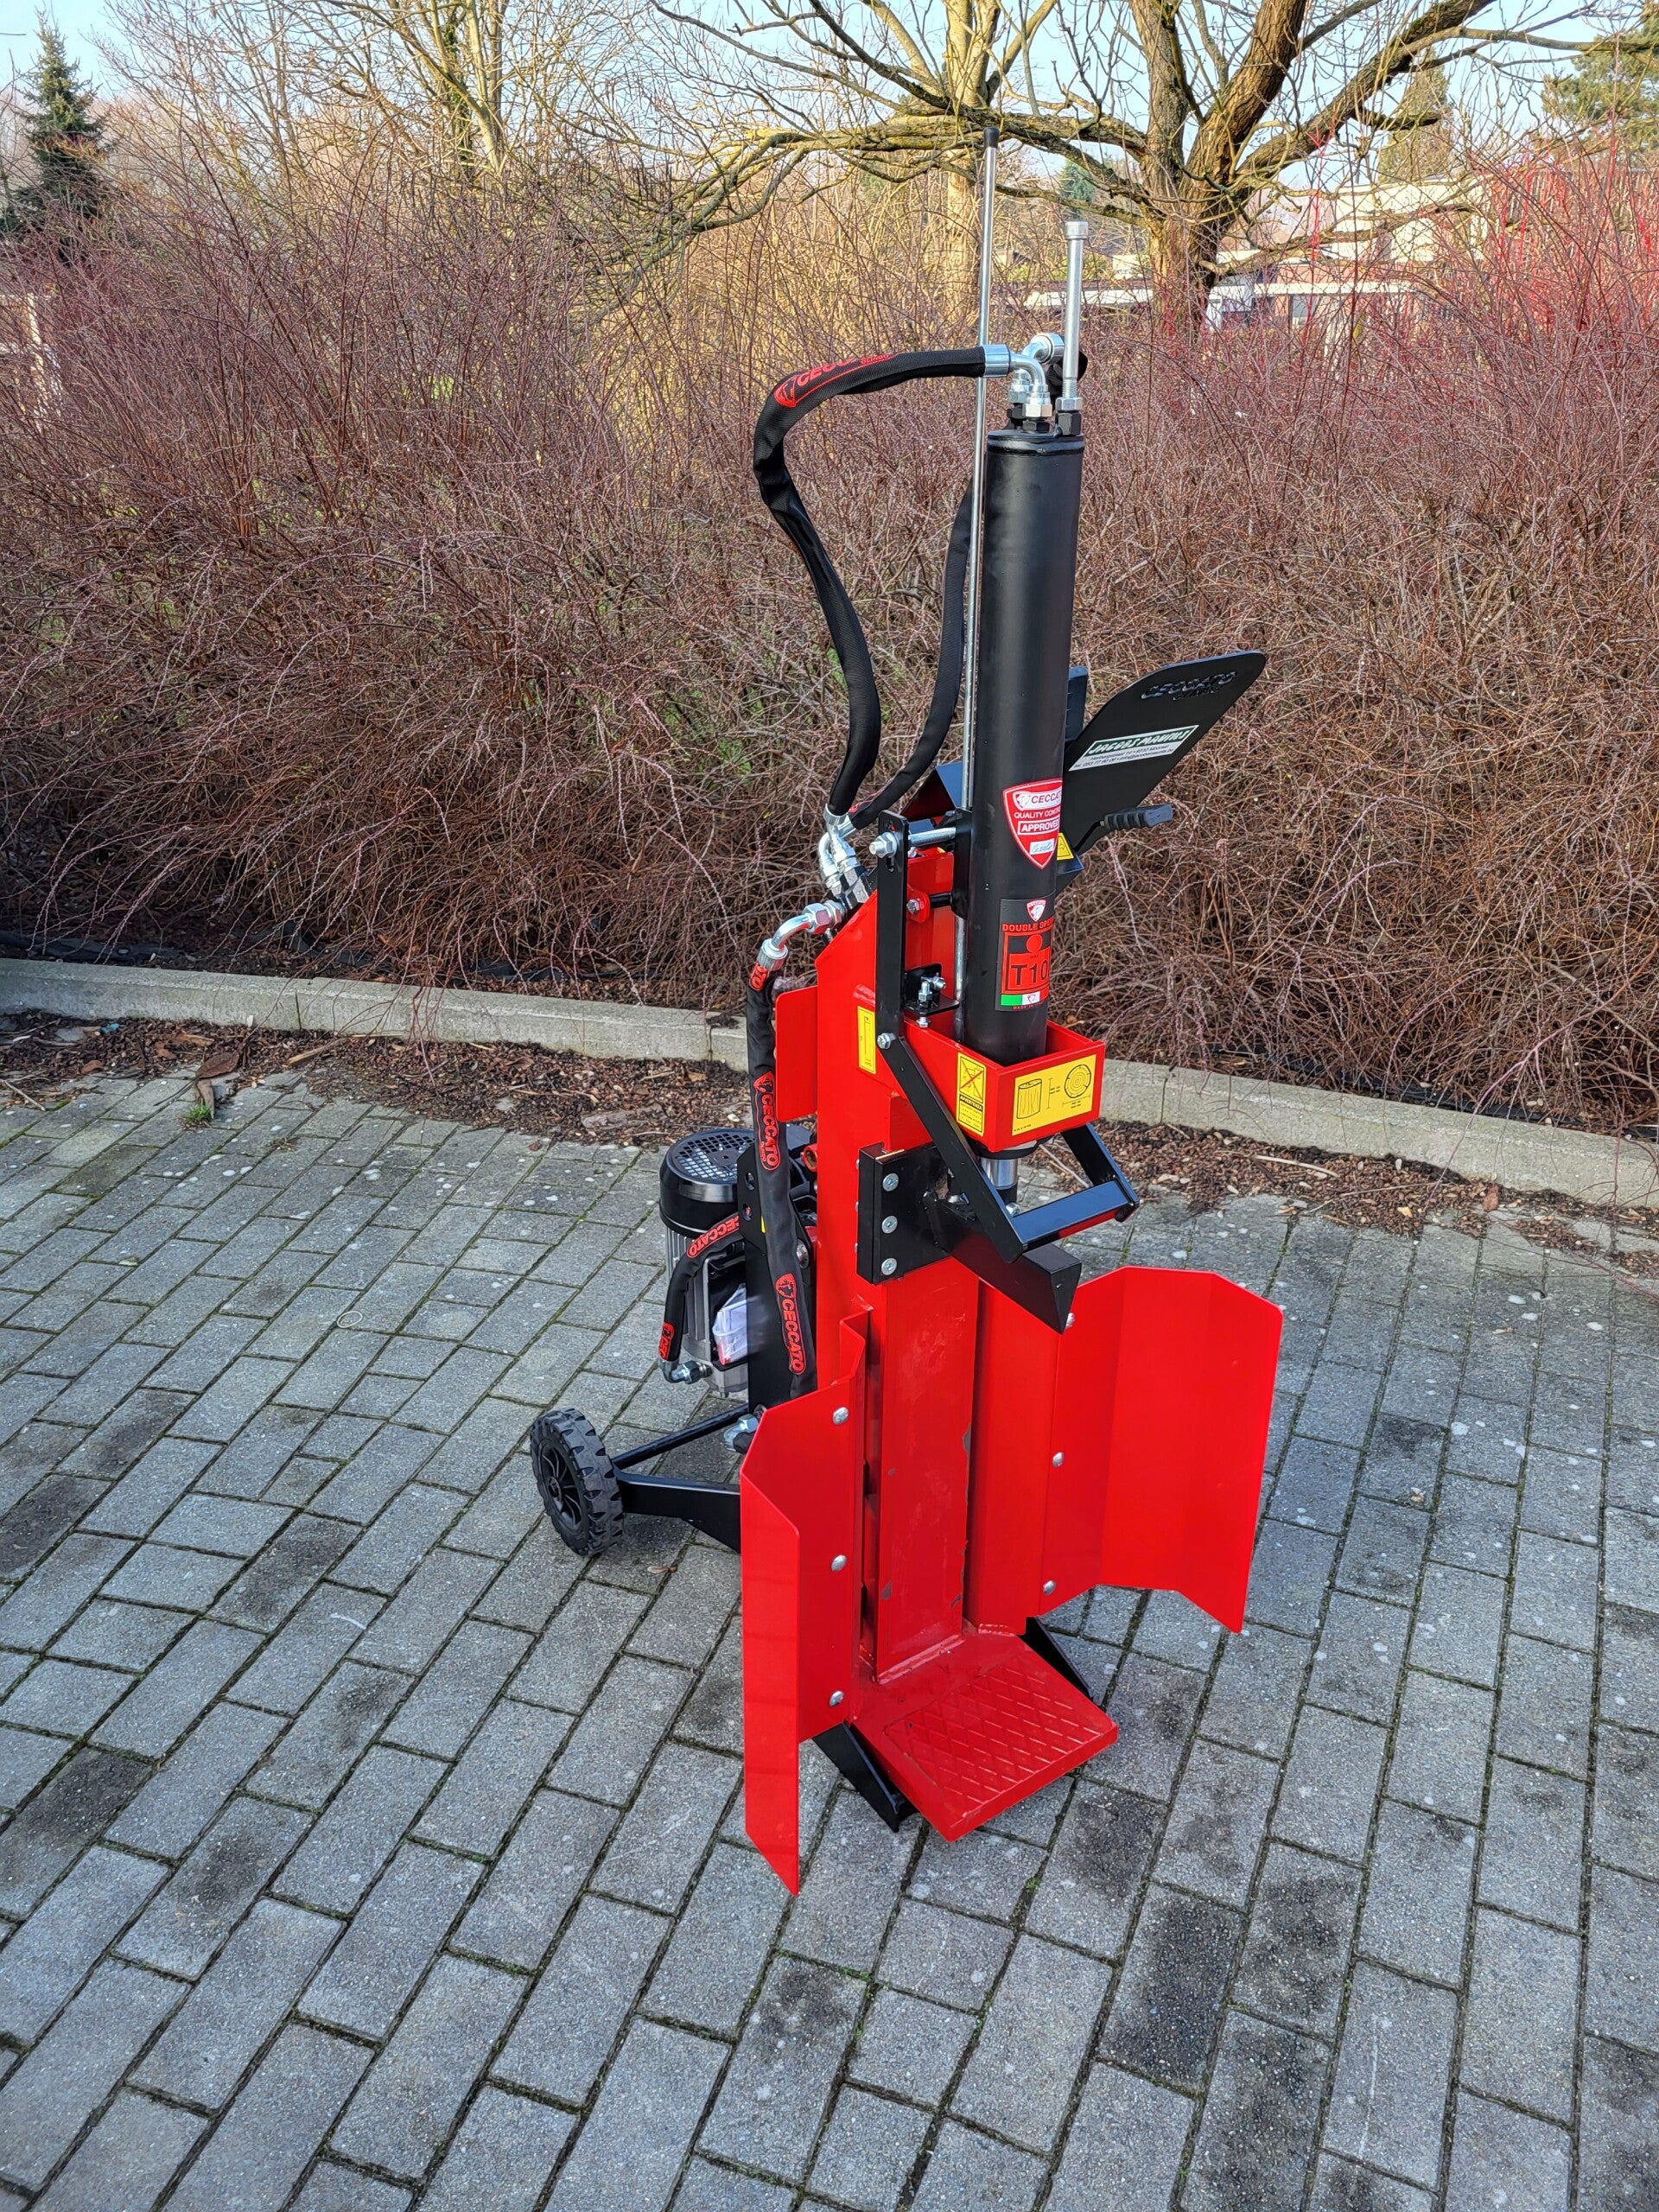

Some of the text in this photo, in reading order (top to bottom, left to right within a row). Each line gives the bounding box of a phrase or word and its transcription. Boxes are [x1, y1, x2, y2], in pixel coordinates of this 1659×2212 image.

[1089, 739, 1137, 754] JACOBS
[1014, 810, 1044, 819] QUALITY
[1002, 923, 1038, 931] DOUBLE
[1011, 960, 1048, 986] T10
[761, 1093, 779, 1166] CECCATO
[782, 1299, 804, 1371] CECCATO
